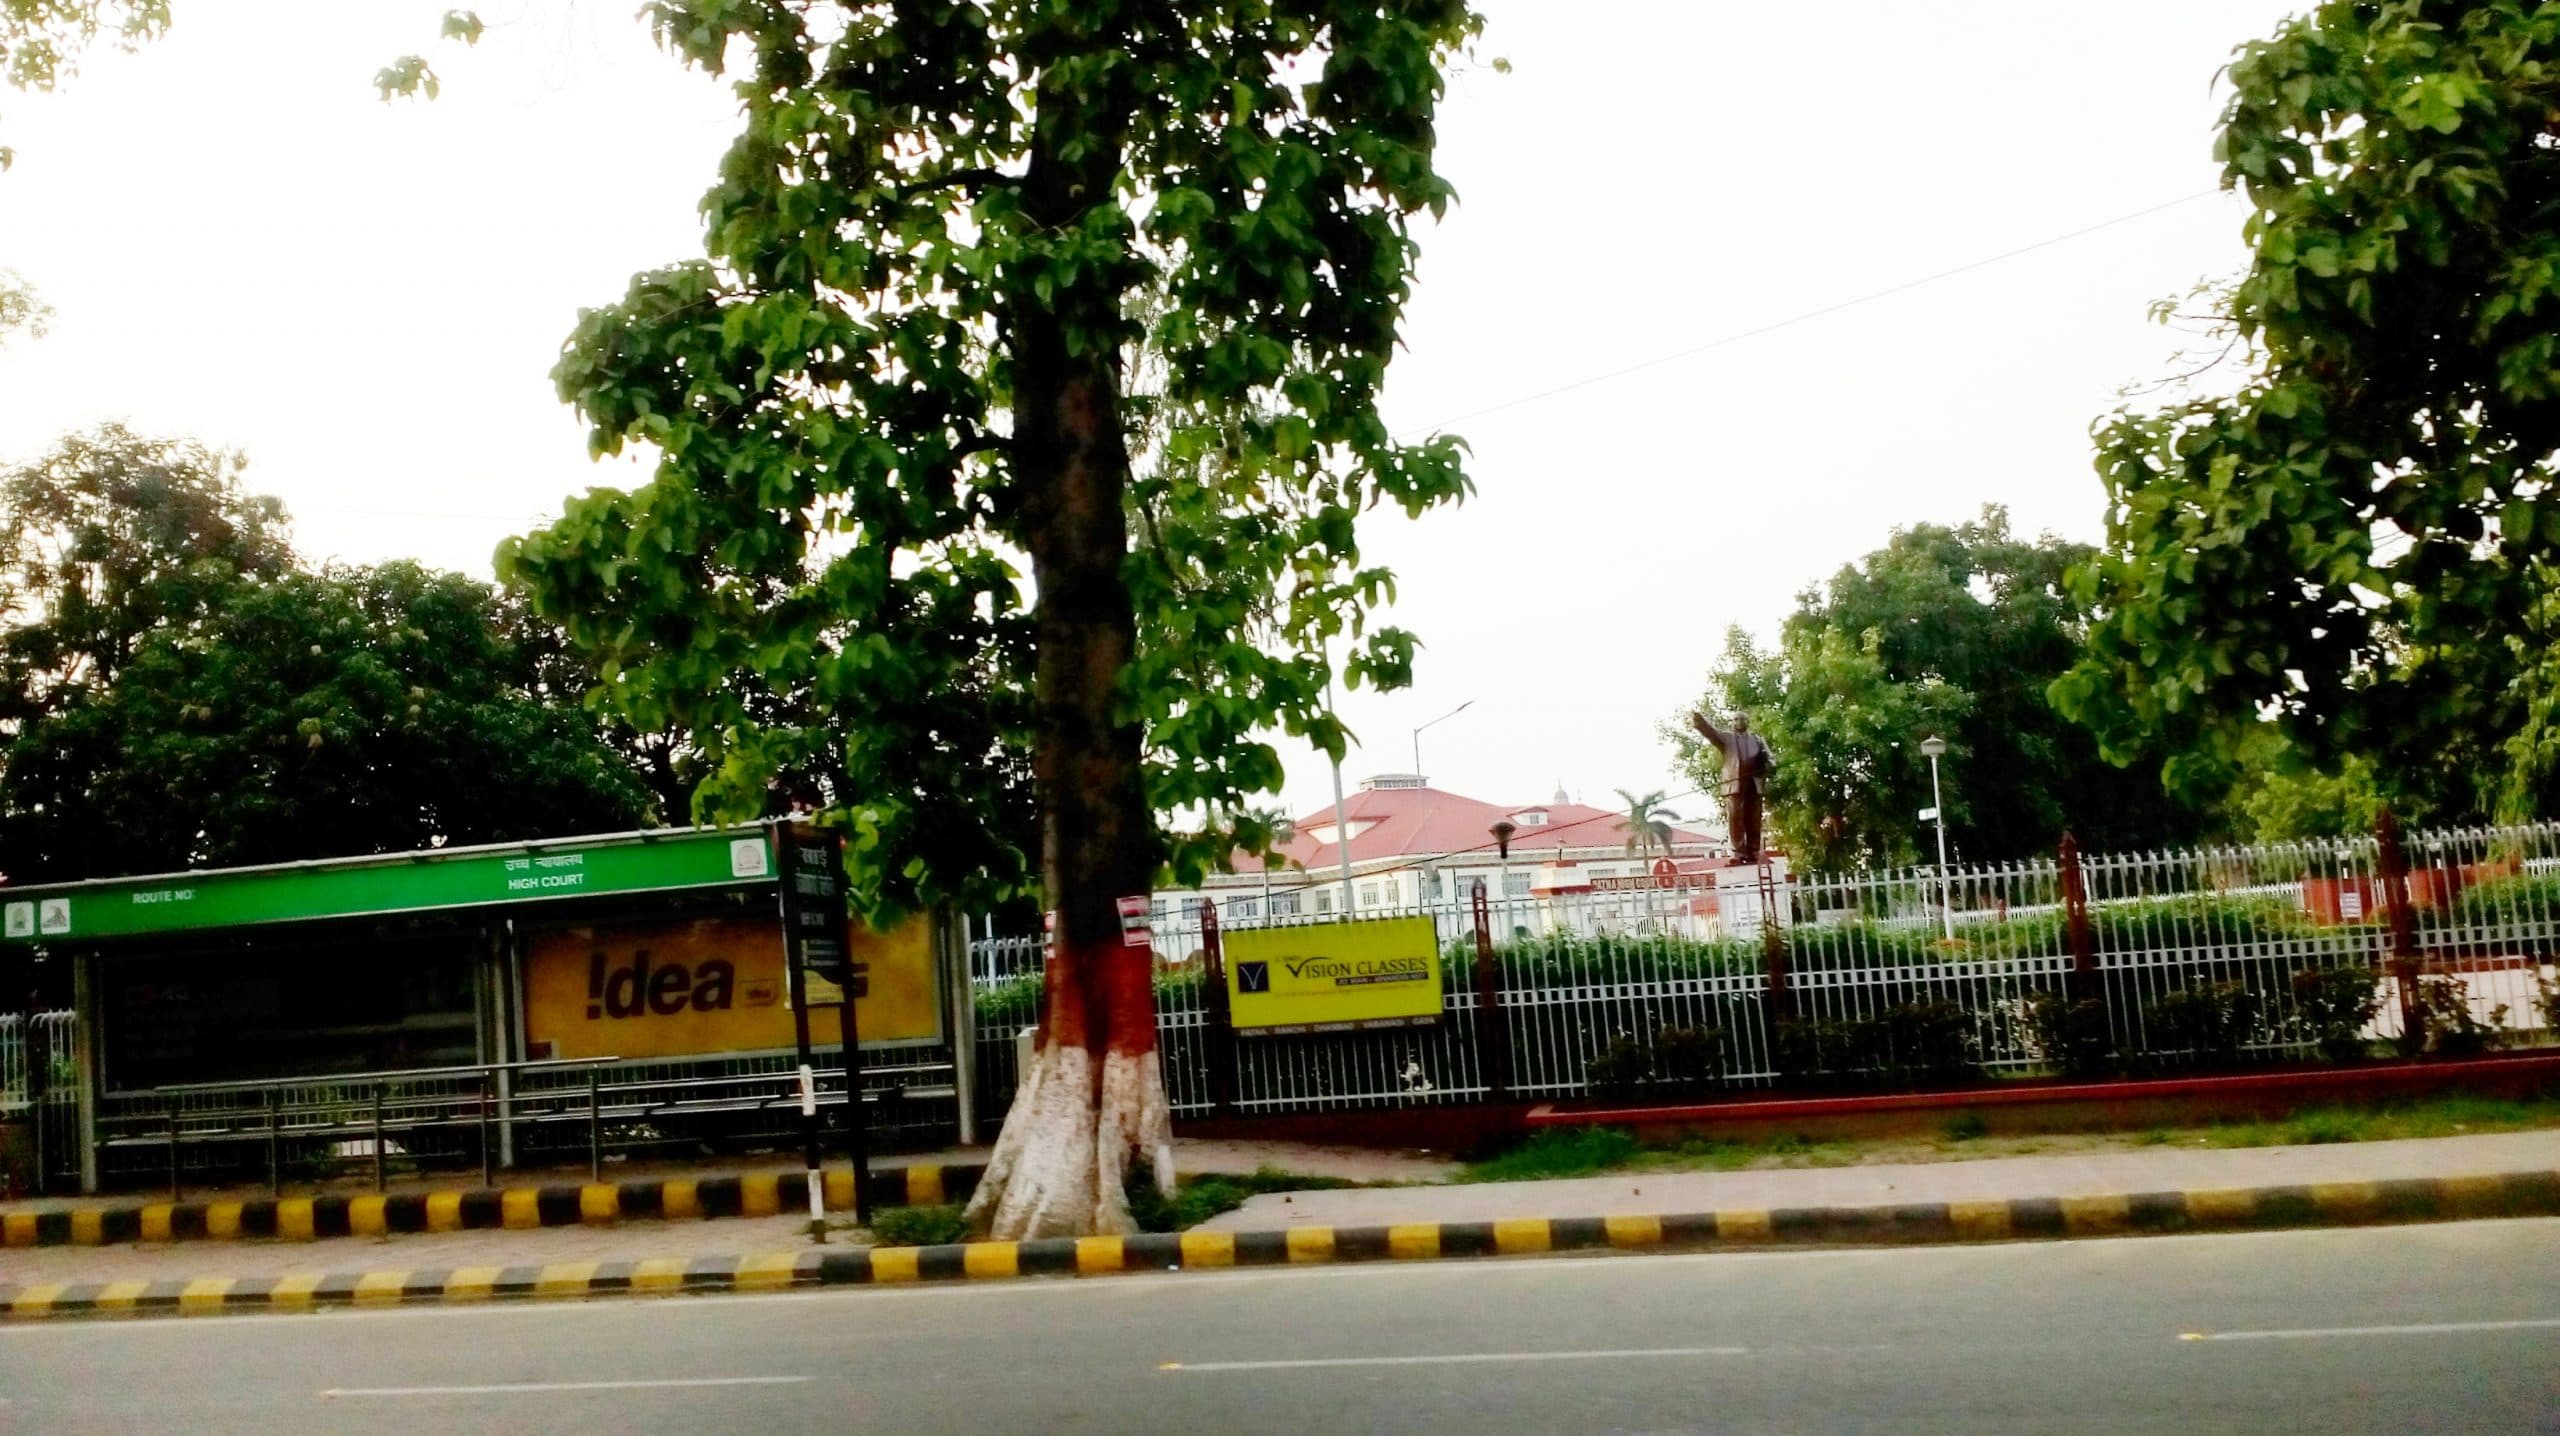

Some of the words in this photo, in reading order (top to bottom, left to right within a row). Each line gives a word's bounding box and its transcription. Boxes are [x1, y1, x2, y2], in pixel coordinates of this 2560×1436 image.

[508, 878, 539, 891] HIGH
[541, 873, 584, 888] COURT
[132, 890, 173, 904] ROUTE
[1286, 957, 1350, 979] VISION
[1356, 957, 1427, 976] CLASSES
